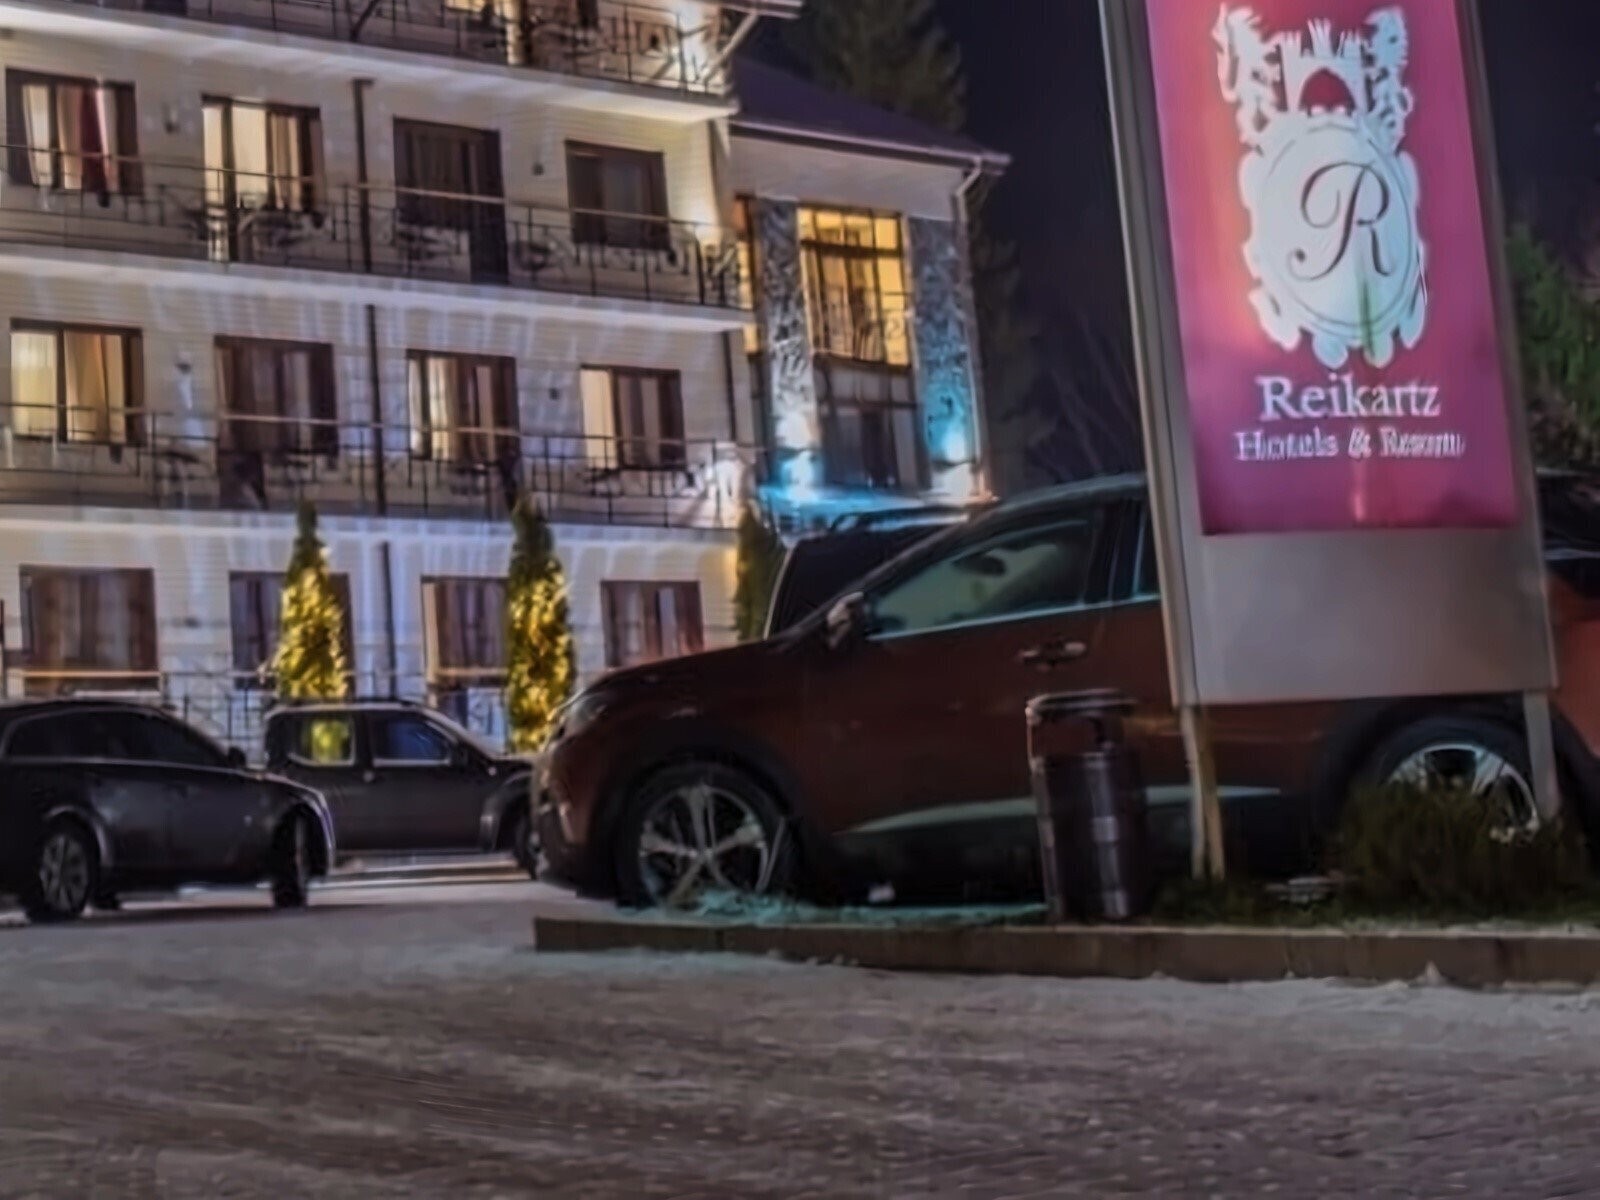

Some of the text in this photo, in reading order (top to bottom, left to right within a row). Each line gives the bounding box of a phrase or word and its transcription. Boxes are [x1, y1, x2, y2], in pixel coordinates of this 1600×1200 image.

[1288, 161, 1392, 281] R
[1256, 372, 1441, 421] Reikartz
[1235, 427, 1339, 460] Hotels
[1348, 426, 1373, 459] &
